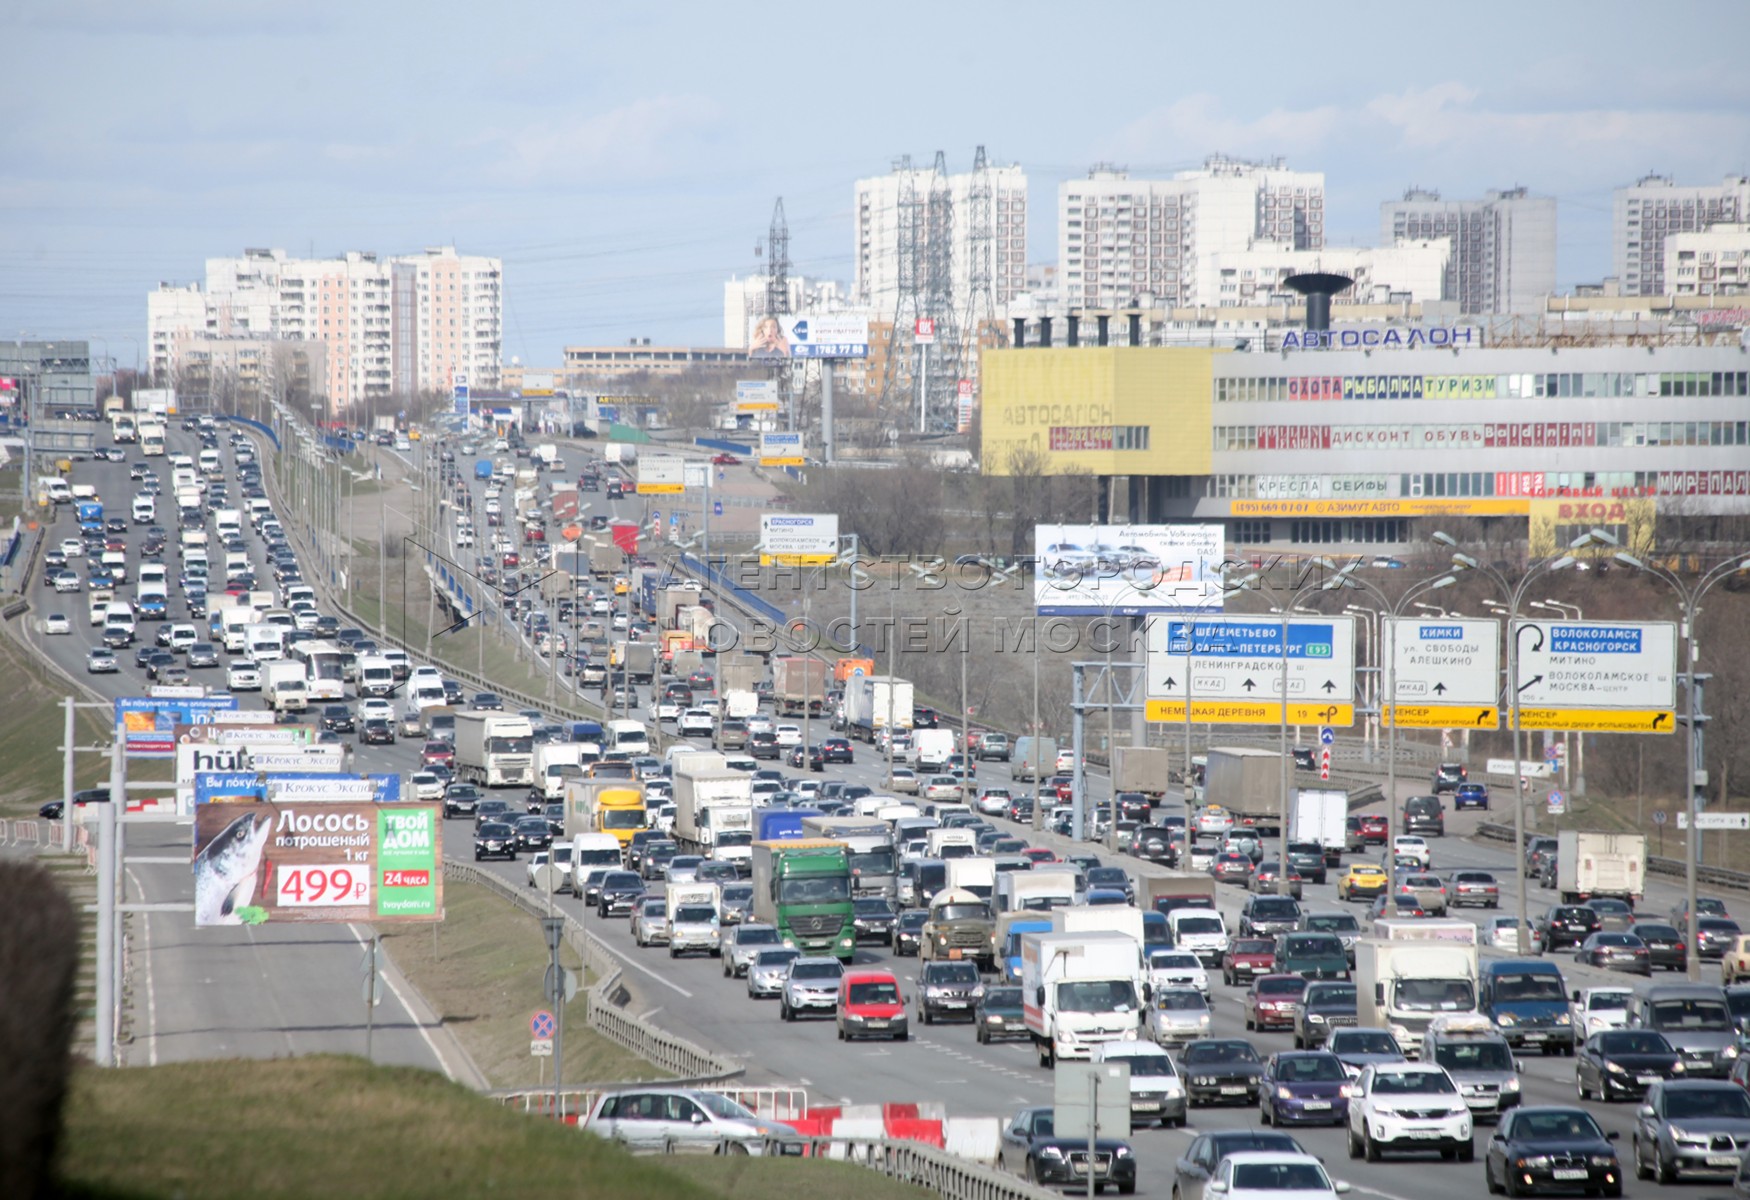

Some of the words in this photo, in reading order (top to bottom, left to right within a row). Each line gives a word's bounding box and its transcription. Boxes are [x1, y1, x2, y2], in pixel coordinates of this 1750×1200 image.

[1282, 327, 1472, 348] АВТОСАЛОН
[838, 345, 850, 354] 77
[1289, 380, 1342, 395] ОХОТА
[1344, 378, 1422, 394] РЫБАЛКА
[1425, 378, 1495, 392] ТУРИЗМ
[1003, 403, 1113, 425] АВТОСАЛОН
[1485, 424, 1592, 438] Baldinini
[1332, 431, 1410, 444] ДИСКОНТ
[1425, 431, 1482, 442] ОБУВЬ
[1258, 481, 1320, 492] КРЕСЛА
[1332, 480, 1388, 492] СЕЙФЫ
[1660, 474, 1696, 492] МИР
[1611, 486, 1657, 498] ЦЕНТР
[1327, 502, 1369, 513] АЗИМУТ
[1371, 502, 1400, 513] АВТО
[1557, 502, 1627, 521] ВХОД
[1195, 627, 1277, 638] ШЕРЕМЕТЬЕВО
[1421, 628, 1461, 638] ХИМКИ
[1552, 628, 1639, 640] ВОЛОКОЛАМСК
[1403, 646, 1418, 654] ул.
[1425, 644, 1479, 654] СВОБОДЫ
[1554, 641, 1637, 652] КРАСНОГОРСК
[1409, 656, 1472, 665] АЛЕШКИНО
[1549, 656, 1596, 665] МИТИНО
[1549, 671, 1650, 682] ВОЛОКОЛАМСКОЕ
[1196, 679, 1221, 688] МКАД
[1398, 684, 1424, 692] МКАД
[1160, 707, 1215, 717] НЕМЕЦКАЯ
[1217, 708, 1266, 717] ДЕРЕВНЯ
[1297, 710, 1307, 718] 19
[265, 756, 302, 765] КРОКУС
[308, 756, 340, 765] ЭКСПО
[206, 777, 223, 788] Вы
[284, 782, 329, 794] КРОКУС
[333, 783, 370, 793] ЭКСПО
[275, 809, 369, 833] Лосось
[385, 812, 429, 830] ТВОЙ
[275, 833, 370, 850] потрошеный
[383, 830, 430, 849] ДОМ
[343, 848, 352, 861] 1
[354, 850, 369, 862] кг
[385, 872, 403, 885] 24
[403, 877, 428, 885] ЧАСА
[383, 900, 430, 911] tvoydom.ru
